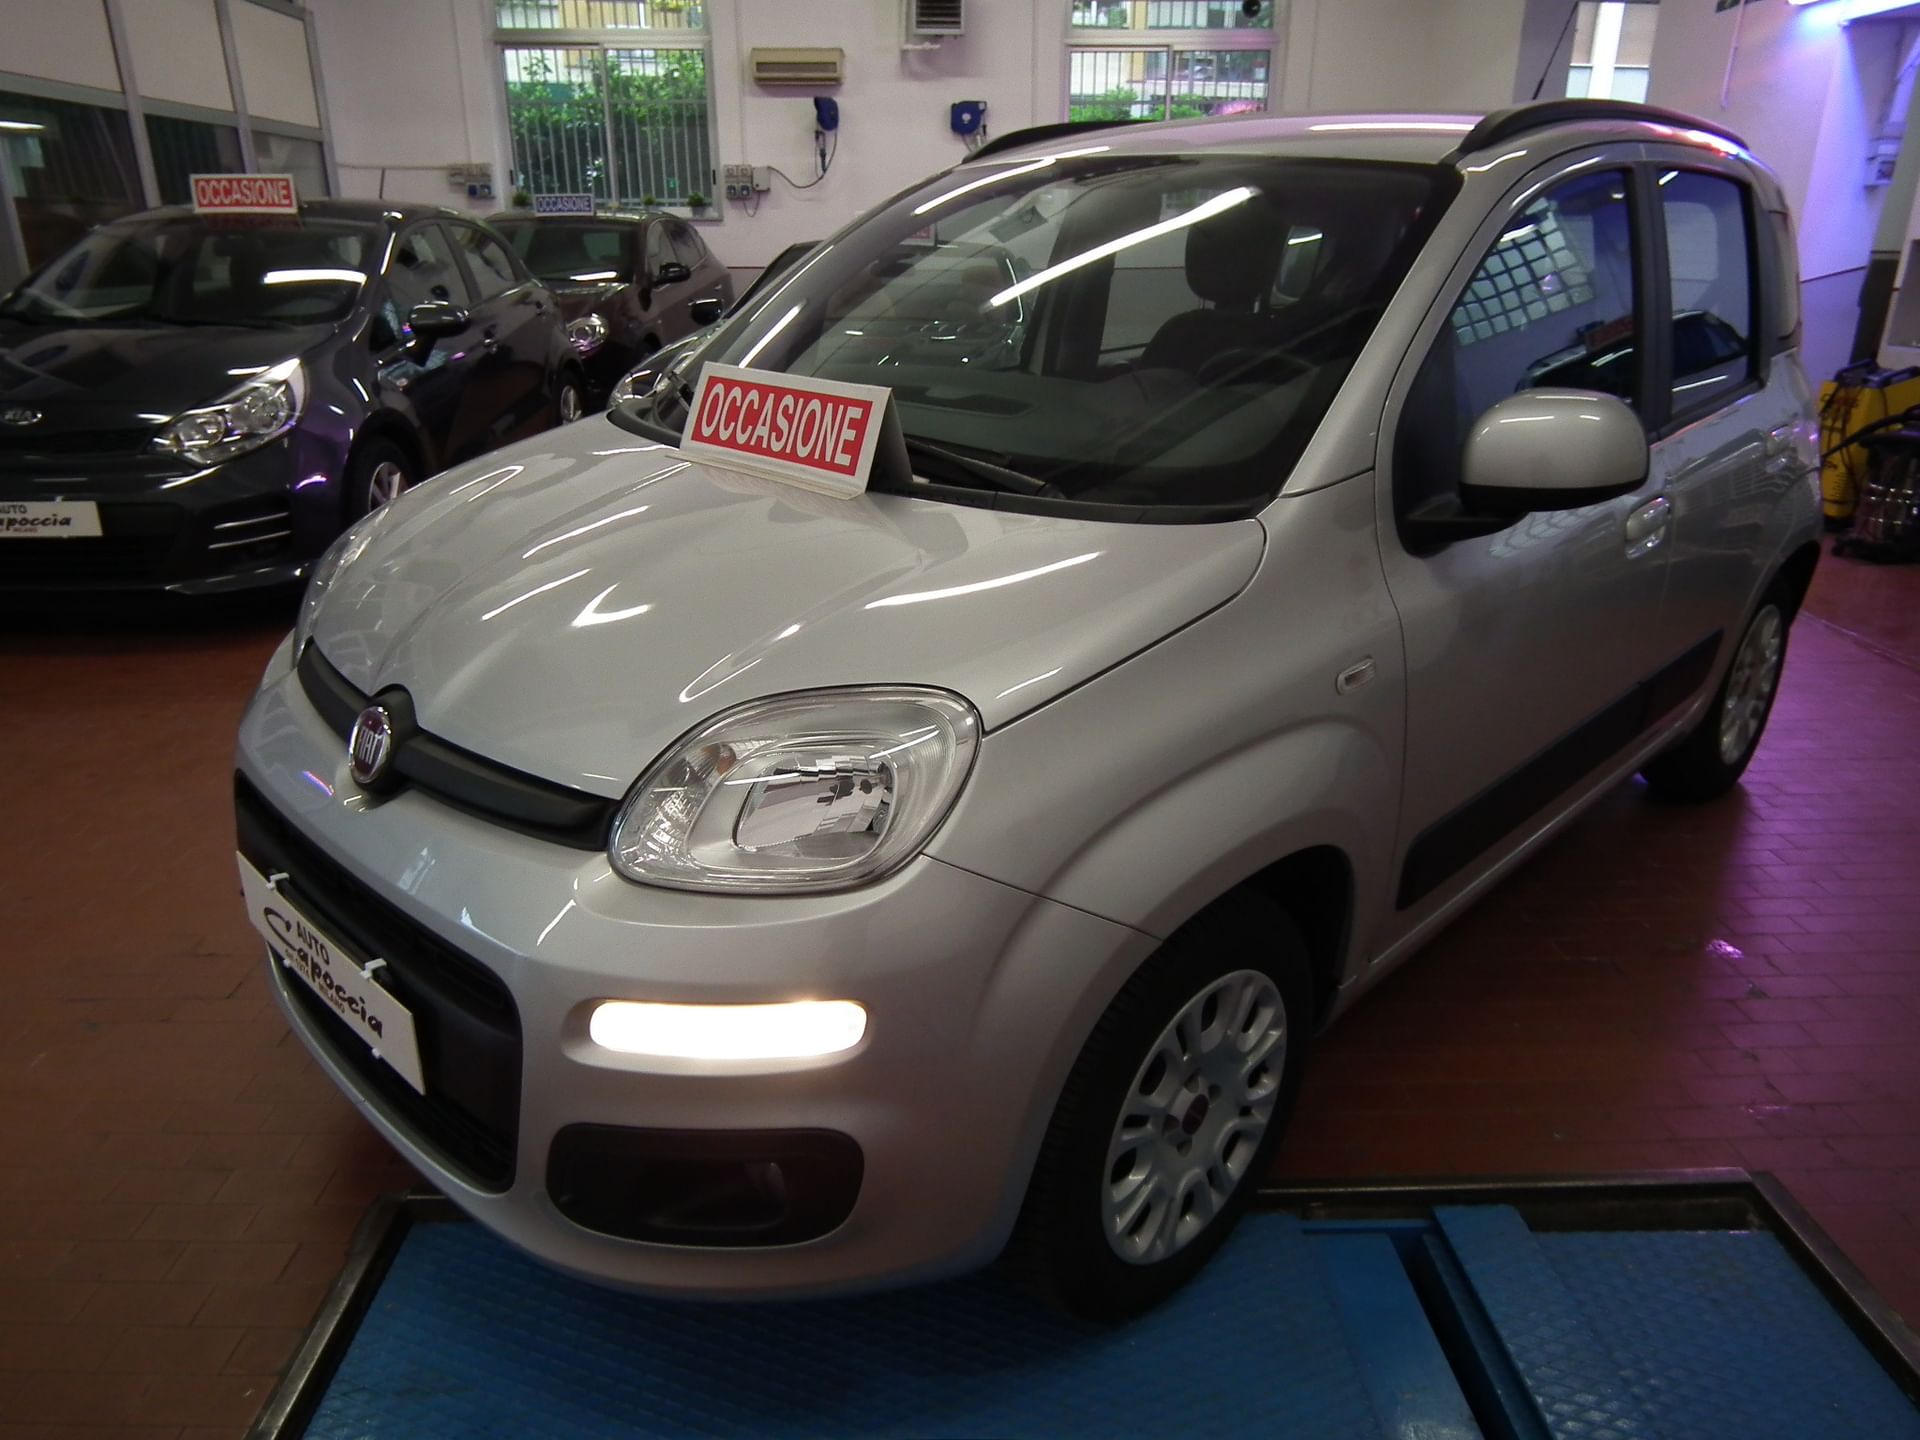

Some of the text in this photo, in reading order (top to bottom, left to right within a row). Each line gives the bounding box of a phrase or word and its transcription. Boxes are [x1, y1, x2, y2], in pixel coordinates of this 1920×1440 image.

[197, 179, 291, 205] OCCASIONE
[537, 196, 591, 211] OCCASIONE
[701, 382, 864, 467] OCCASIONE
[355, 725, 387, 765] FIAT
[296, 920, 331, 965] AUTO
[263, 907, 383, 1039] Capoccia
